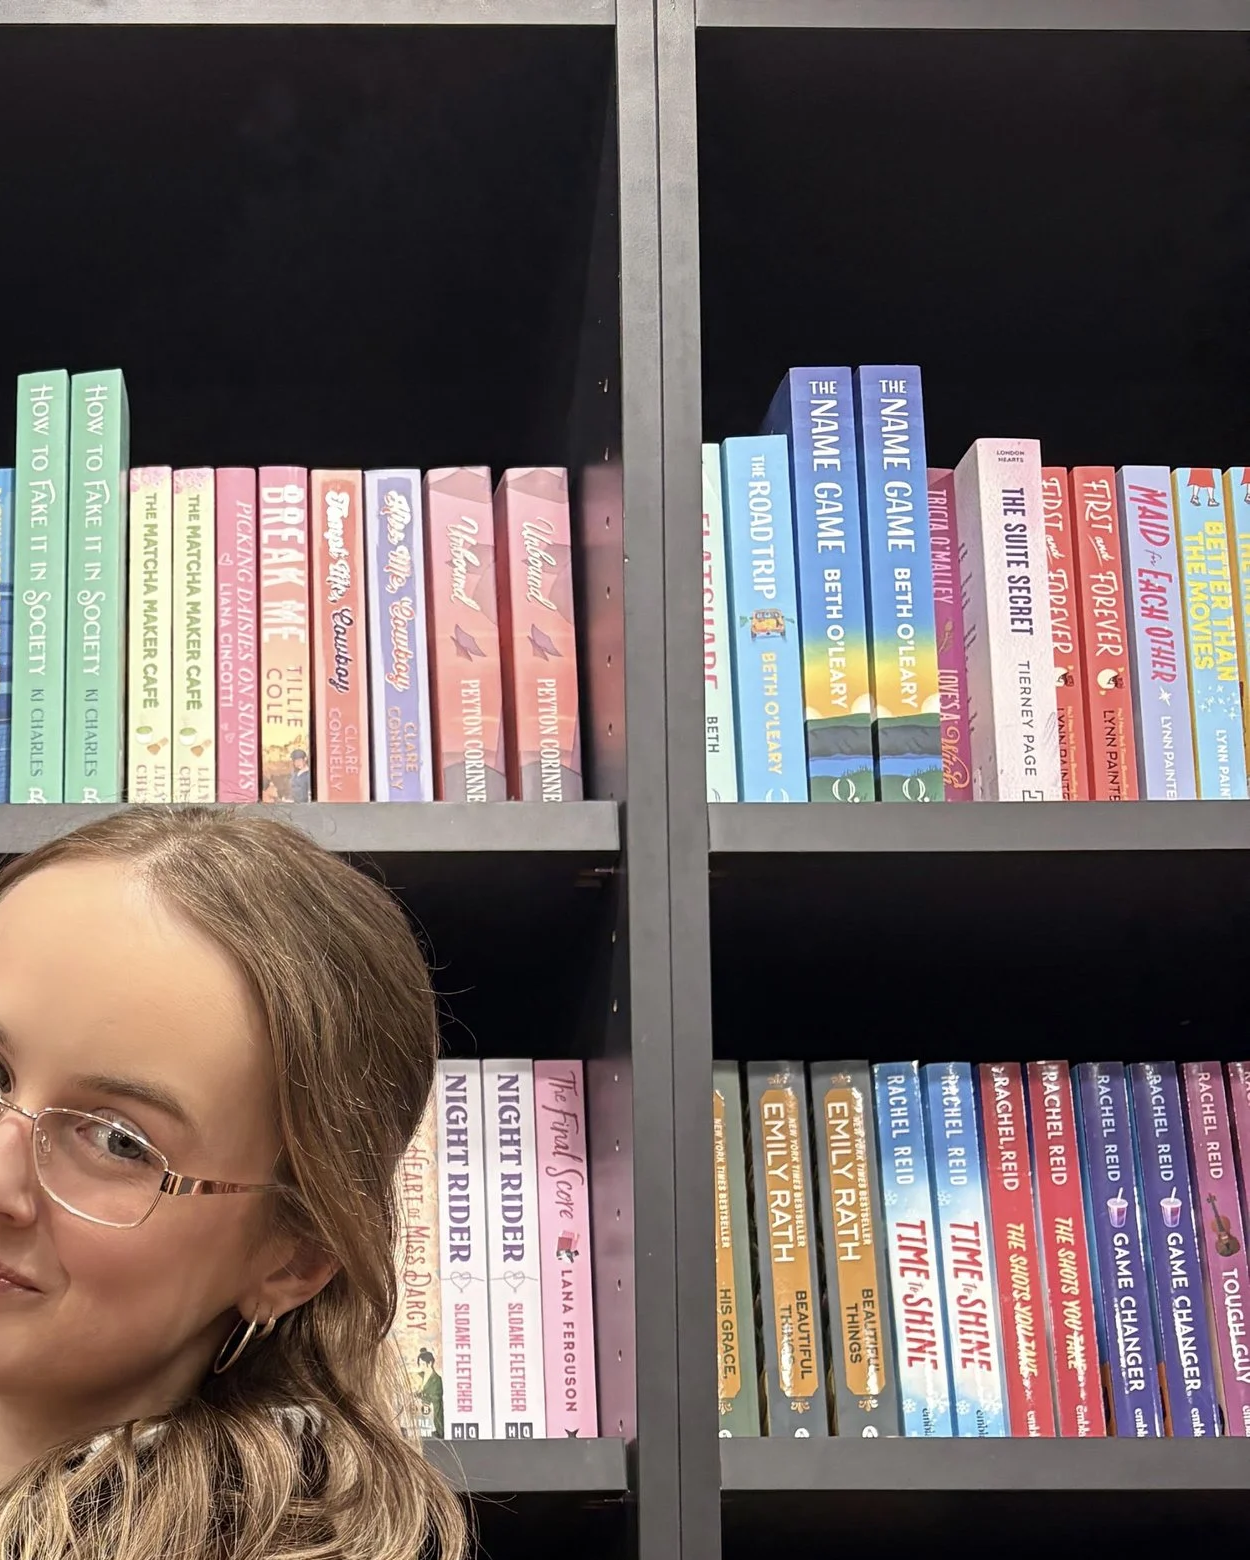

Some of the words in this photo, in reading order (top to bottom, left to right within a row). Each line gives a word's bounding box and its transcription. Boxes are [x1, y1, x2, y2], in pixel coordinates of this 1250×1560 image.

[31, 384, 53, 436] HOW
[810, 381, 837, 394] THE
[31, 445, 48, 472] TO
[809, 399, 841, 472] NAME
[750, 455, 764, 478] THE
[29, 480, 55, 528] FAKE
[145, 492, 157, 519] THE
[748, 481, 775, 543] ROAD
[814, 482, 846, 554] GAME
[1002, 488, 1024, 516] THE
[31, 535, 47, 554] IT
[144, 523, 159, 595] MATCHA
[1004, 522, 1029, 572] SUITE
[31, 562, 47, 581] IN
[751, 545, 777, 599] TRIP
[824, 568, 843, 620] BETH
[142, 599, 158, 660] MAKER
[219, 582, 233, 626] LIANA
[1007, 575, 1033, 635] SECRET
[23, 590, 51, 677] SOCIETY
[219, 632, 233, 707] CINCOTTI
[825, 624, 848, 708] O'LEARY
[31, 689, 44, 703] KJ
[266, 668, 283, 724] COLE
[286, 666, 303, 727] TILLIE
[1018, 661, 1033, 728] TIERNEY
[29, 708, 45, 778] CHARLES
[1022, 733, 1037, 777] PAGE
[887, 1075, 909, 1140] RACHEL
[894, 1145, 914, 1184] REID
[561, 1270, 575, 1313] LANA
[563, 1321, 578, 1412] FERGUSON
